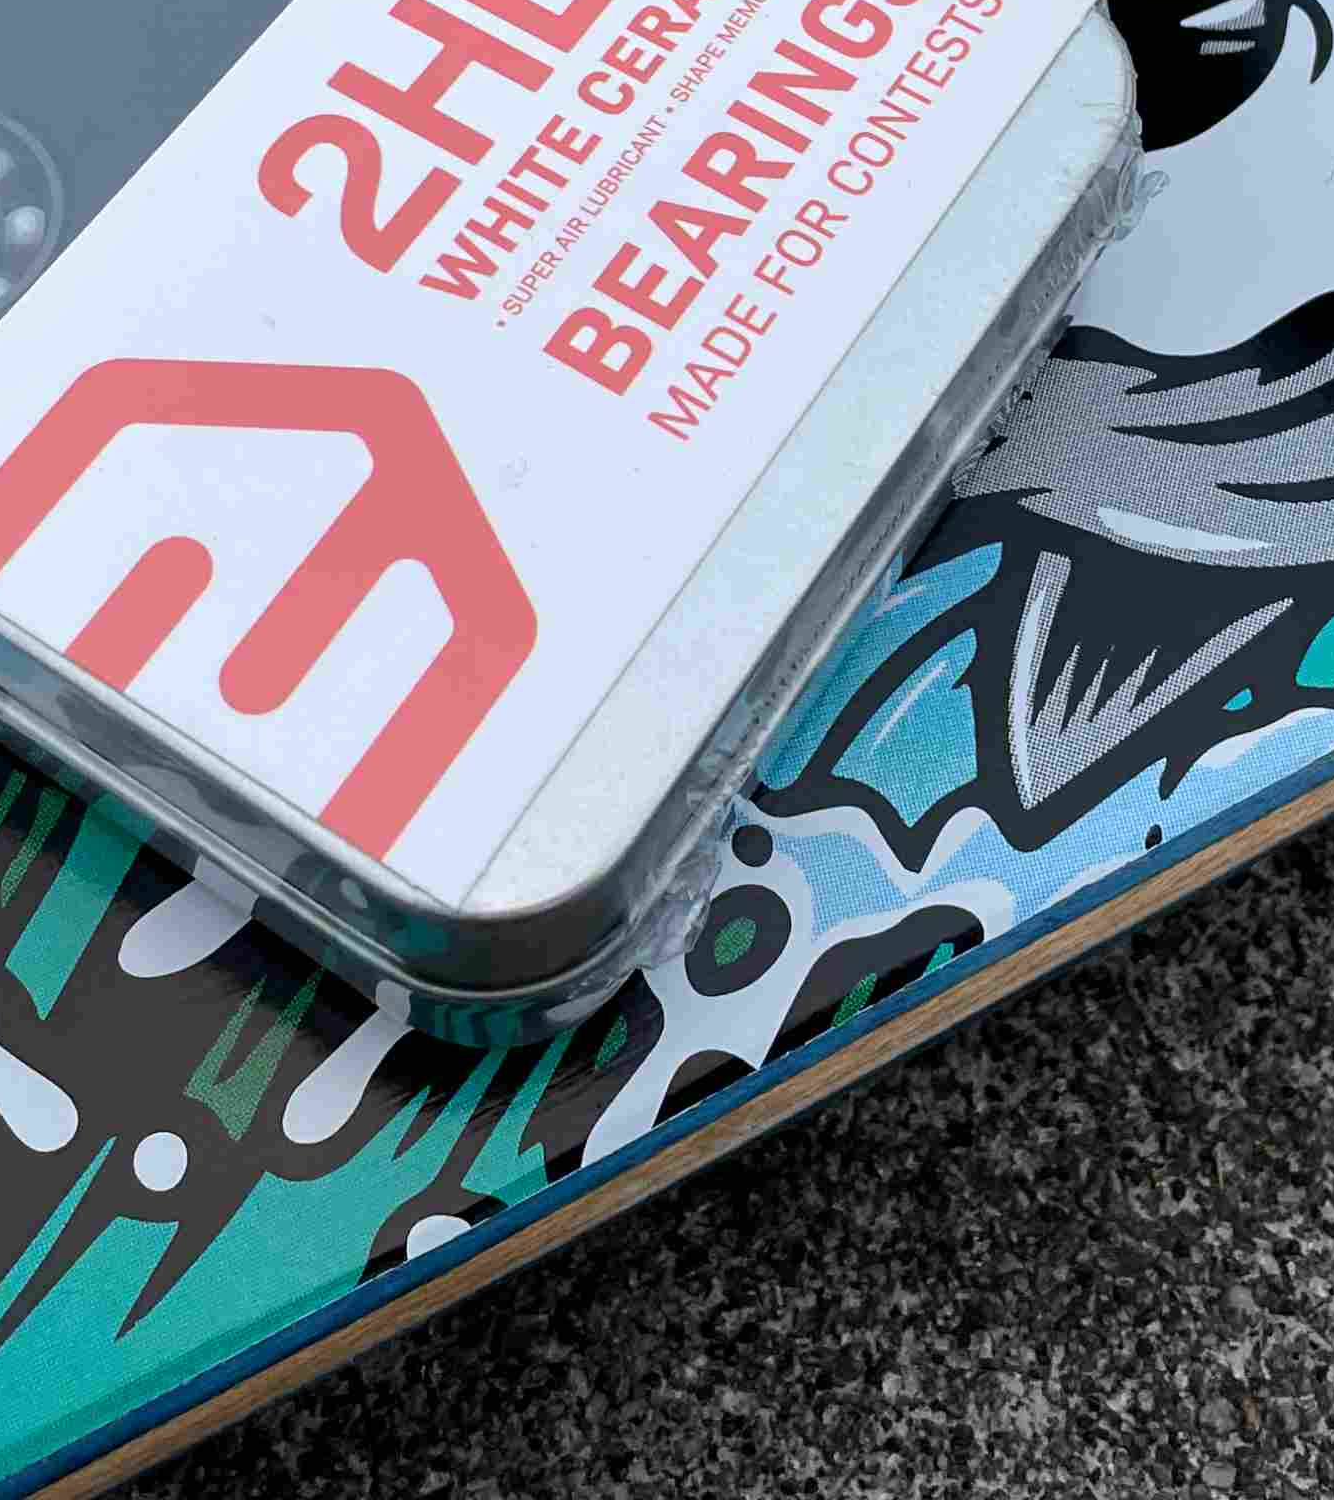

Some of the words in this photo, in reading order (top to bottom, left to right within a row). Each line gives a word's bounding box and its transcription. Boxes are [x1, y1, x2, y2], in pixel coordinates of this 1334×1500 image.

[418, 115, 603, 300] WHITE
[501, 250, 562, 317] SUPER
[555, 216, 591, 255] AIR
[583, 114, 667, 218] LUBRICANT
[669, 43, 727, 104] SHAPE
[645, 293, 778, 443] MADE
[752, 197, 850, 296] FOR
